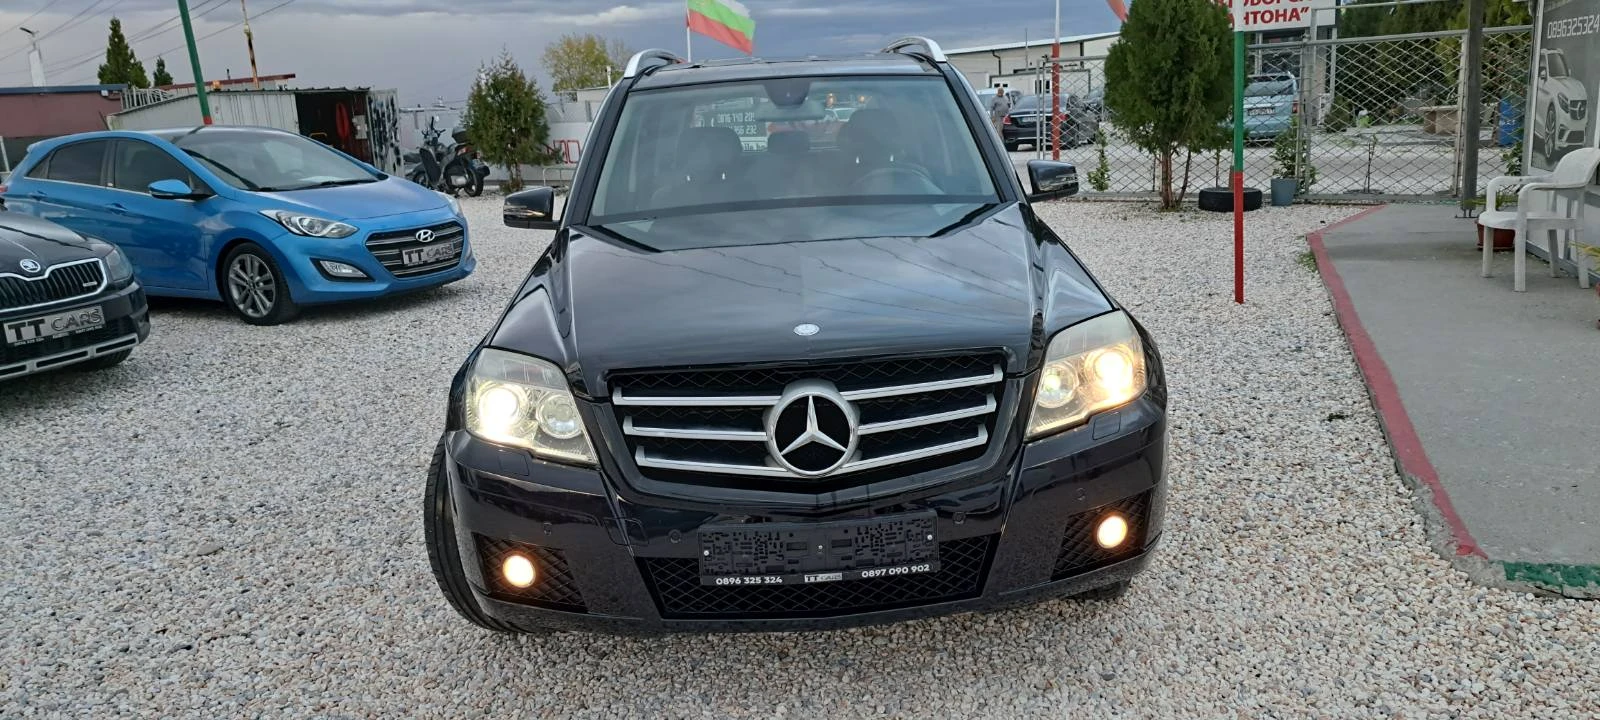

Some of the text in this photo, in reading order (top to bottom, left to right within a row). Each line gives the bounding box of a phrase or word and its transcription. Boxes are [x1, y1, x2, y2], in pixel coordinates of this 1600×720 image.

[1547, 14, 1600, 39] 0896325324
[405, 249, 424, 263] TT
[8, 319, 45, 341] TT
[51, 309, 102, 331] CARS
[861, 564, 930, 578] 0897 090 902
